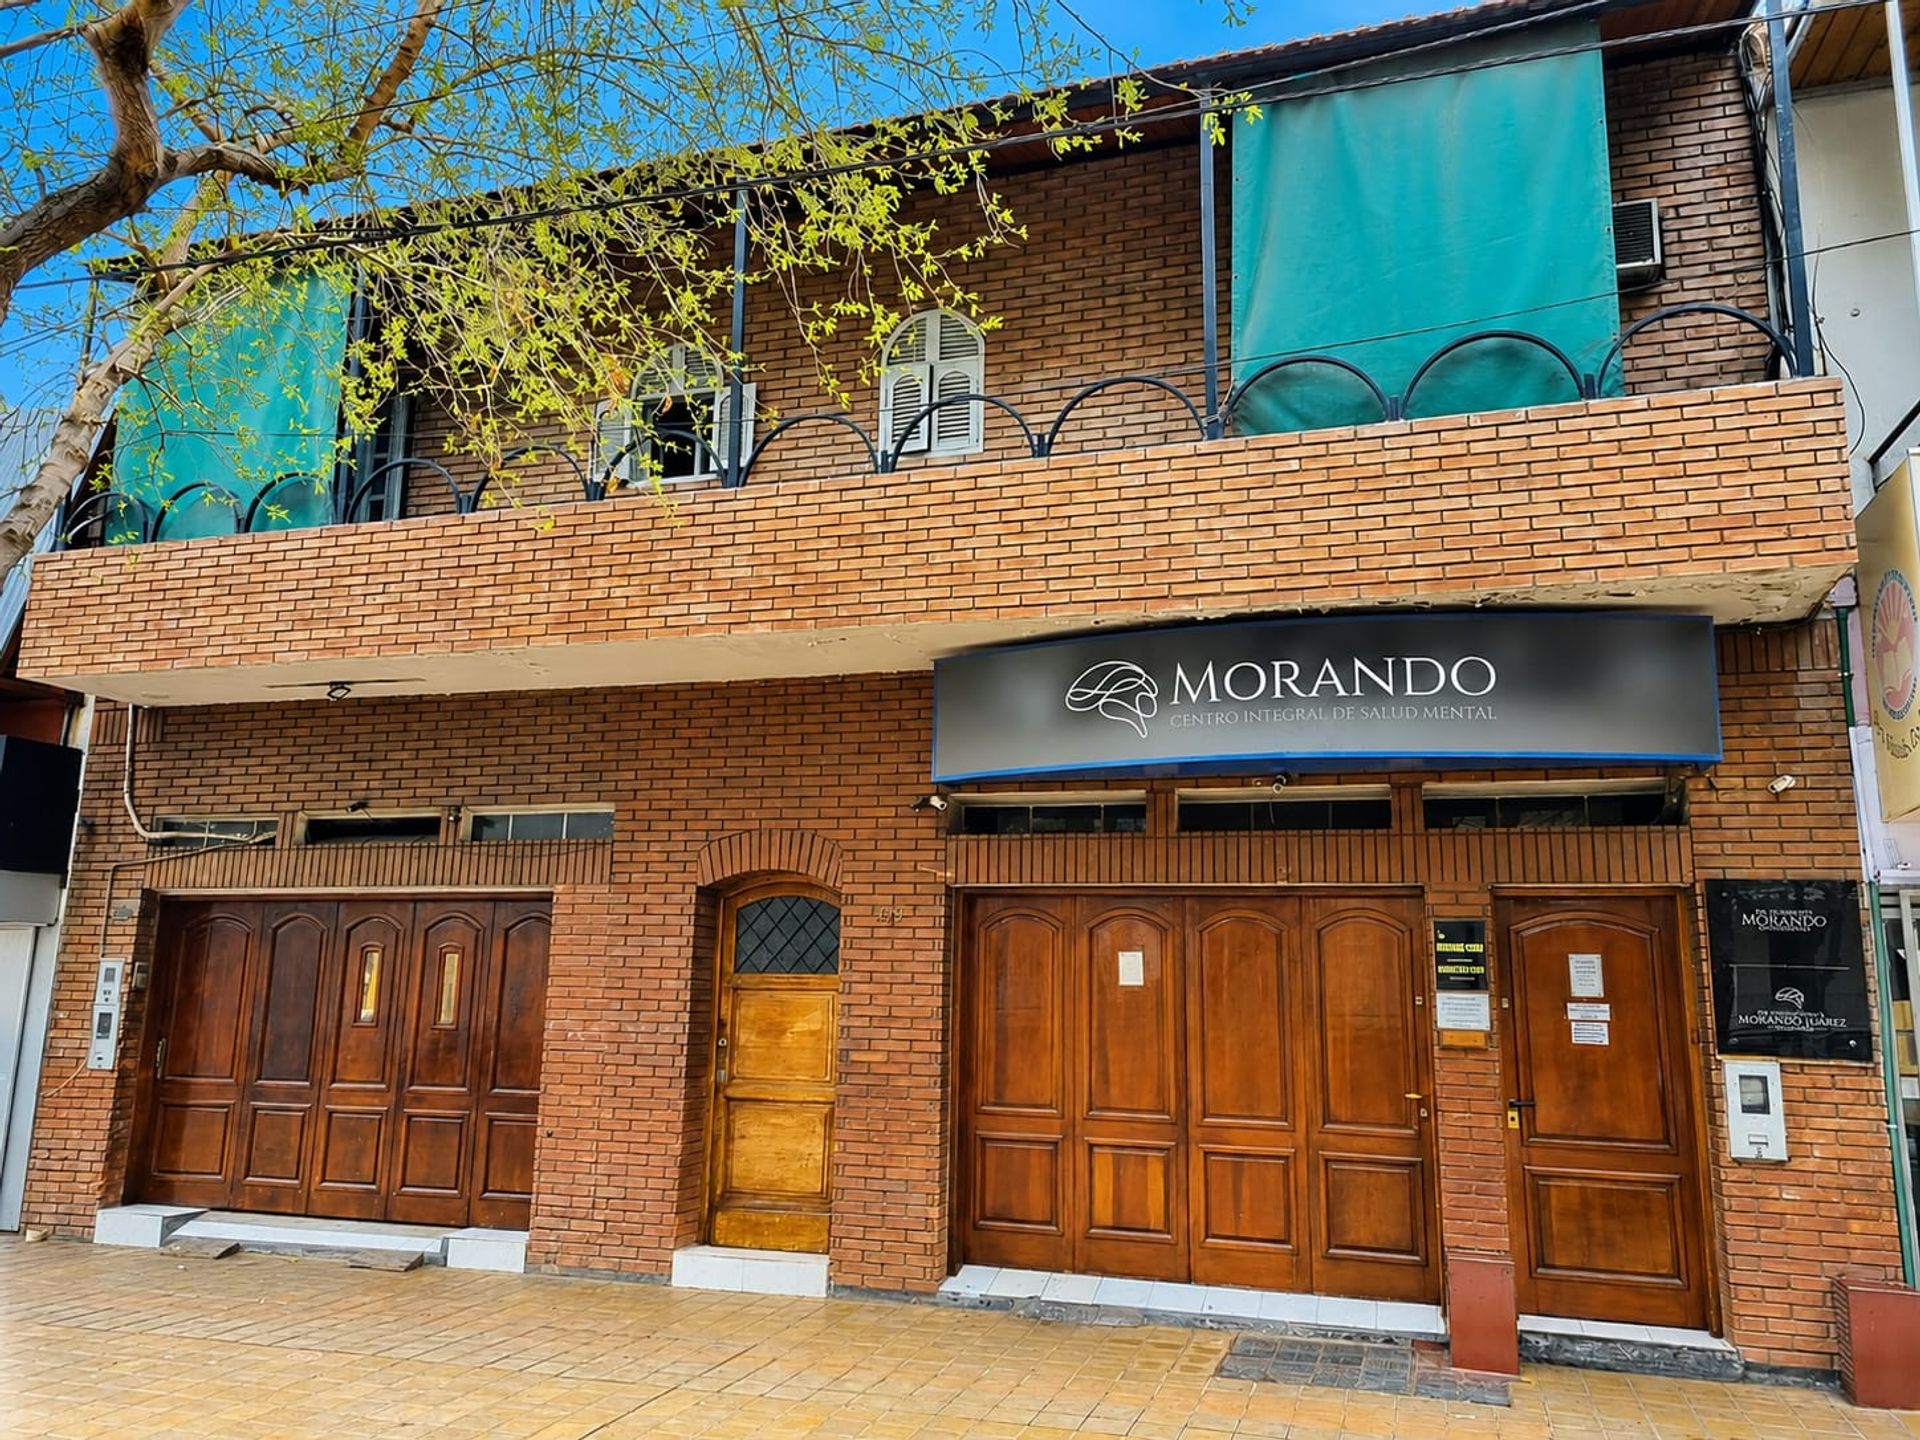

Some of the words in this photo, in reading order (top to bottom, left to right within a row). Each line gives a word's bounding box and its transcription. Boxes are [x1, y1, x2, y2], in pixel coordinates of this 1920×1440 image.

[1169, 655, 1497, 705] MORANDO
[1169, 710, 1239, 729] CENTRO
[1243, 706, 1328, 724] INTEGRAL
[1333, 706, 1356, 721] DE
[1360, 706, 1418, 721] SALUD
[1423, 706, 1497, 721] MENTAL
[1741, 912, 1827, 928] MORANDO
[1738, 1014, 1802, 1026] MORANDO
